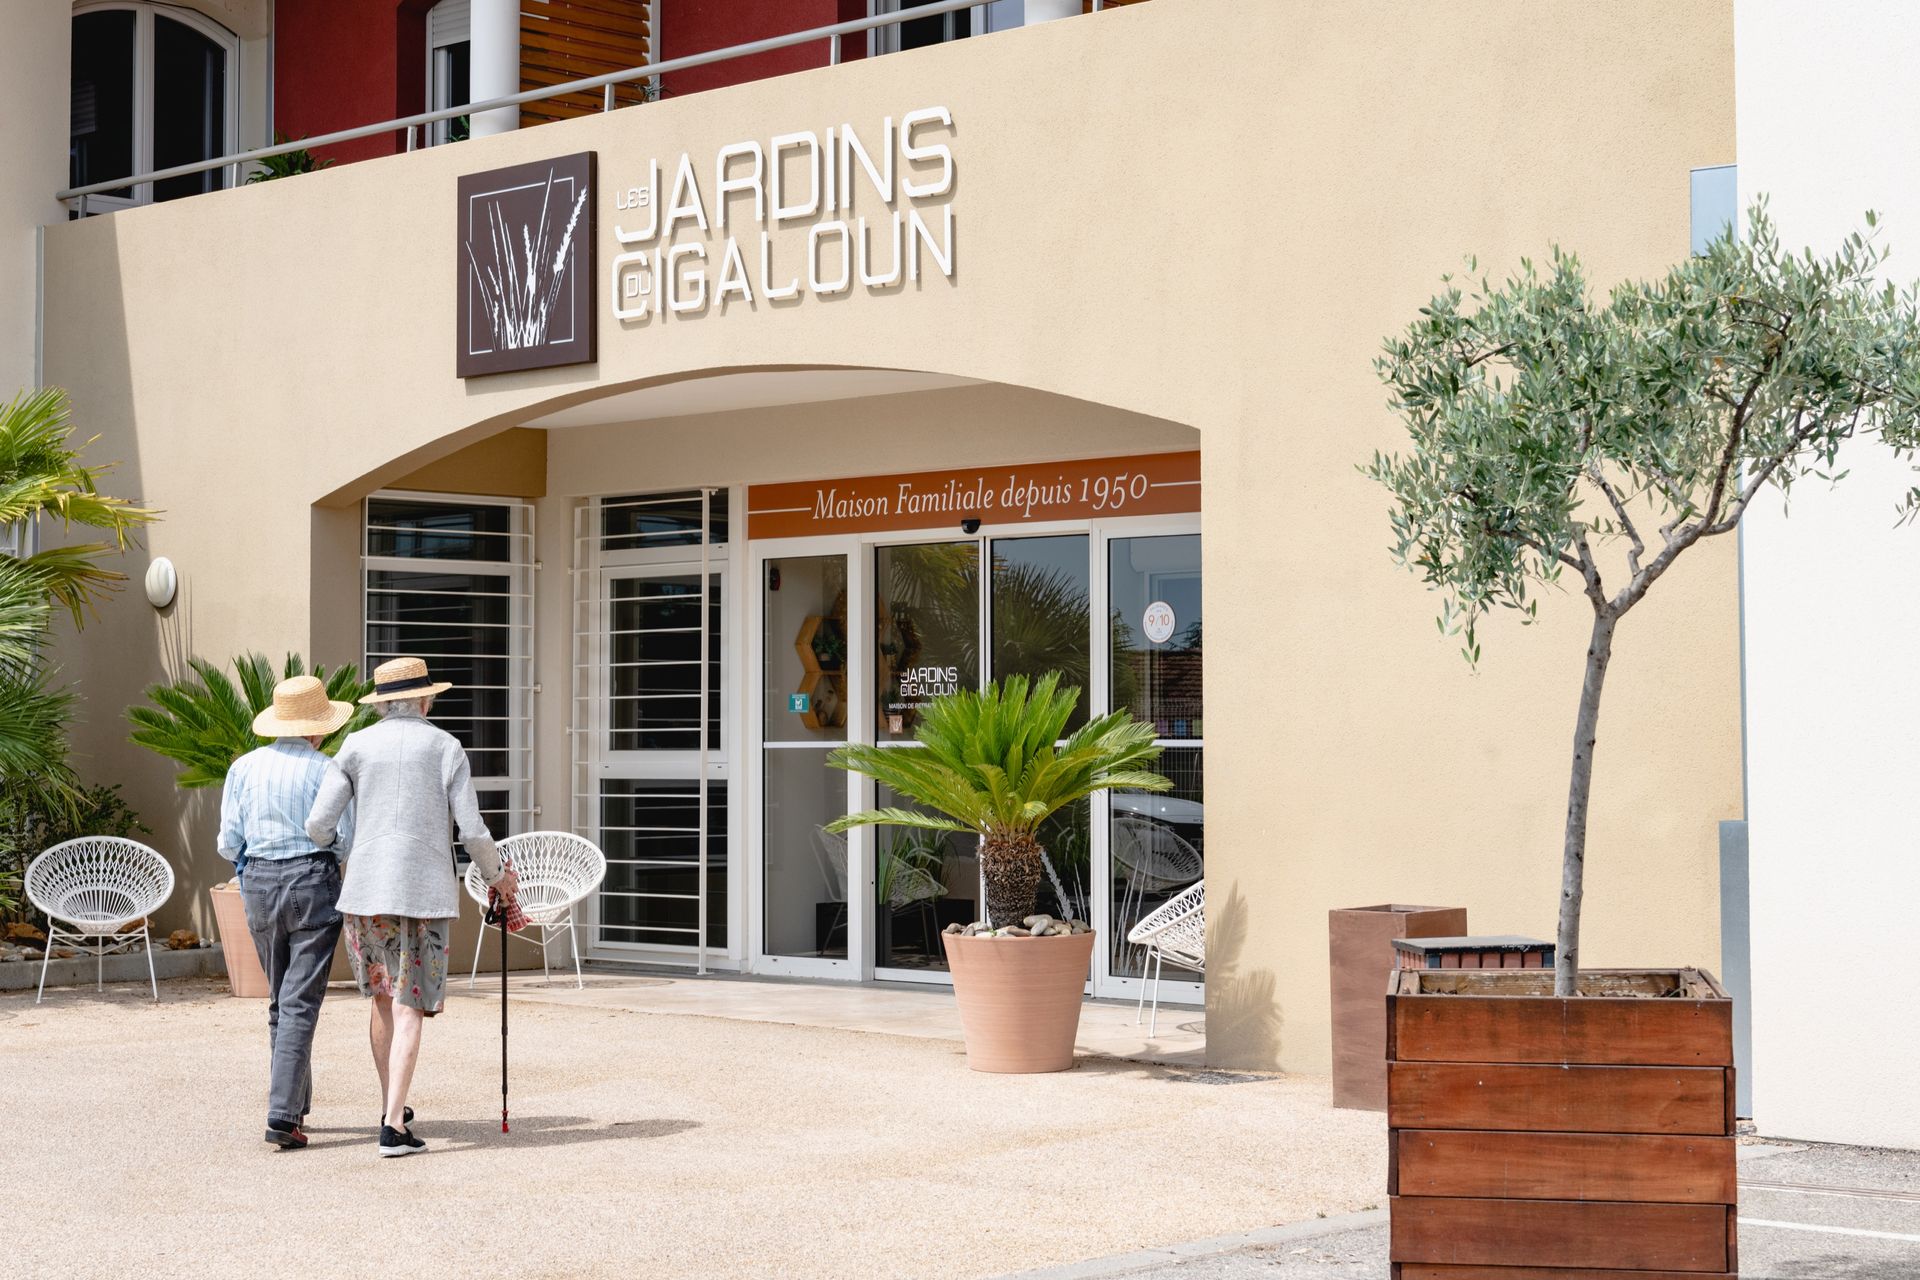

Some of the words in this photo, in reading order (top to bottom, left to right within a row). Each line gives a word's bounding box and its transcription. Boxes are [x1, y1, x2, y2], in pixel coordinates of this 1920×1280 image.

[615, 106, 952, 243] JARDINS
[617, 186, 649, 210] LES
[612, 204, 953, 319] CIGALOUN
[627, 271, 652, 297] DU
[813, 489, 888, 519] Maison
[895, 476, 993, 514] Familiale
[1001, 475, 1071, 517] depuis
[1079, 472, 1147, 510] 1950
[900, 667, 958, 683] JARDINS
[900, 683, 958, 697] CIGALOUN
